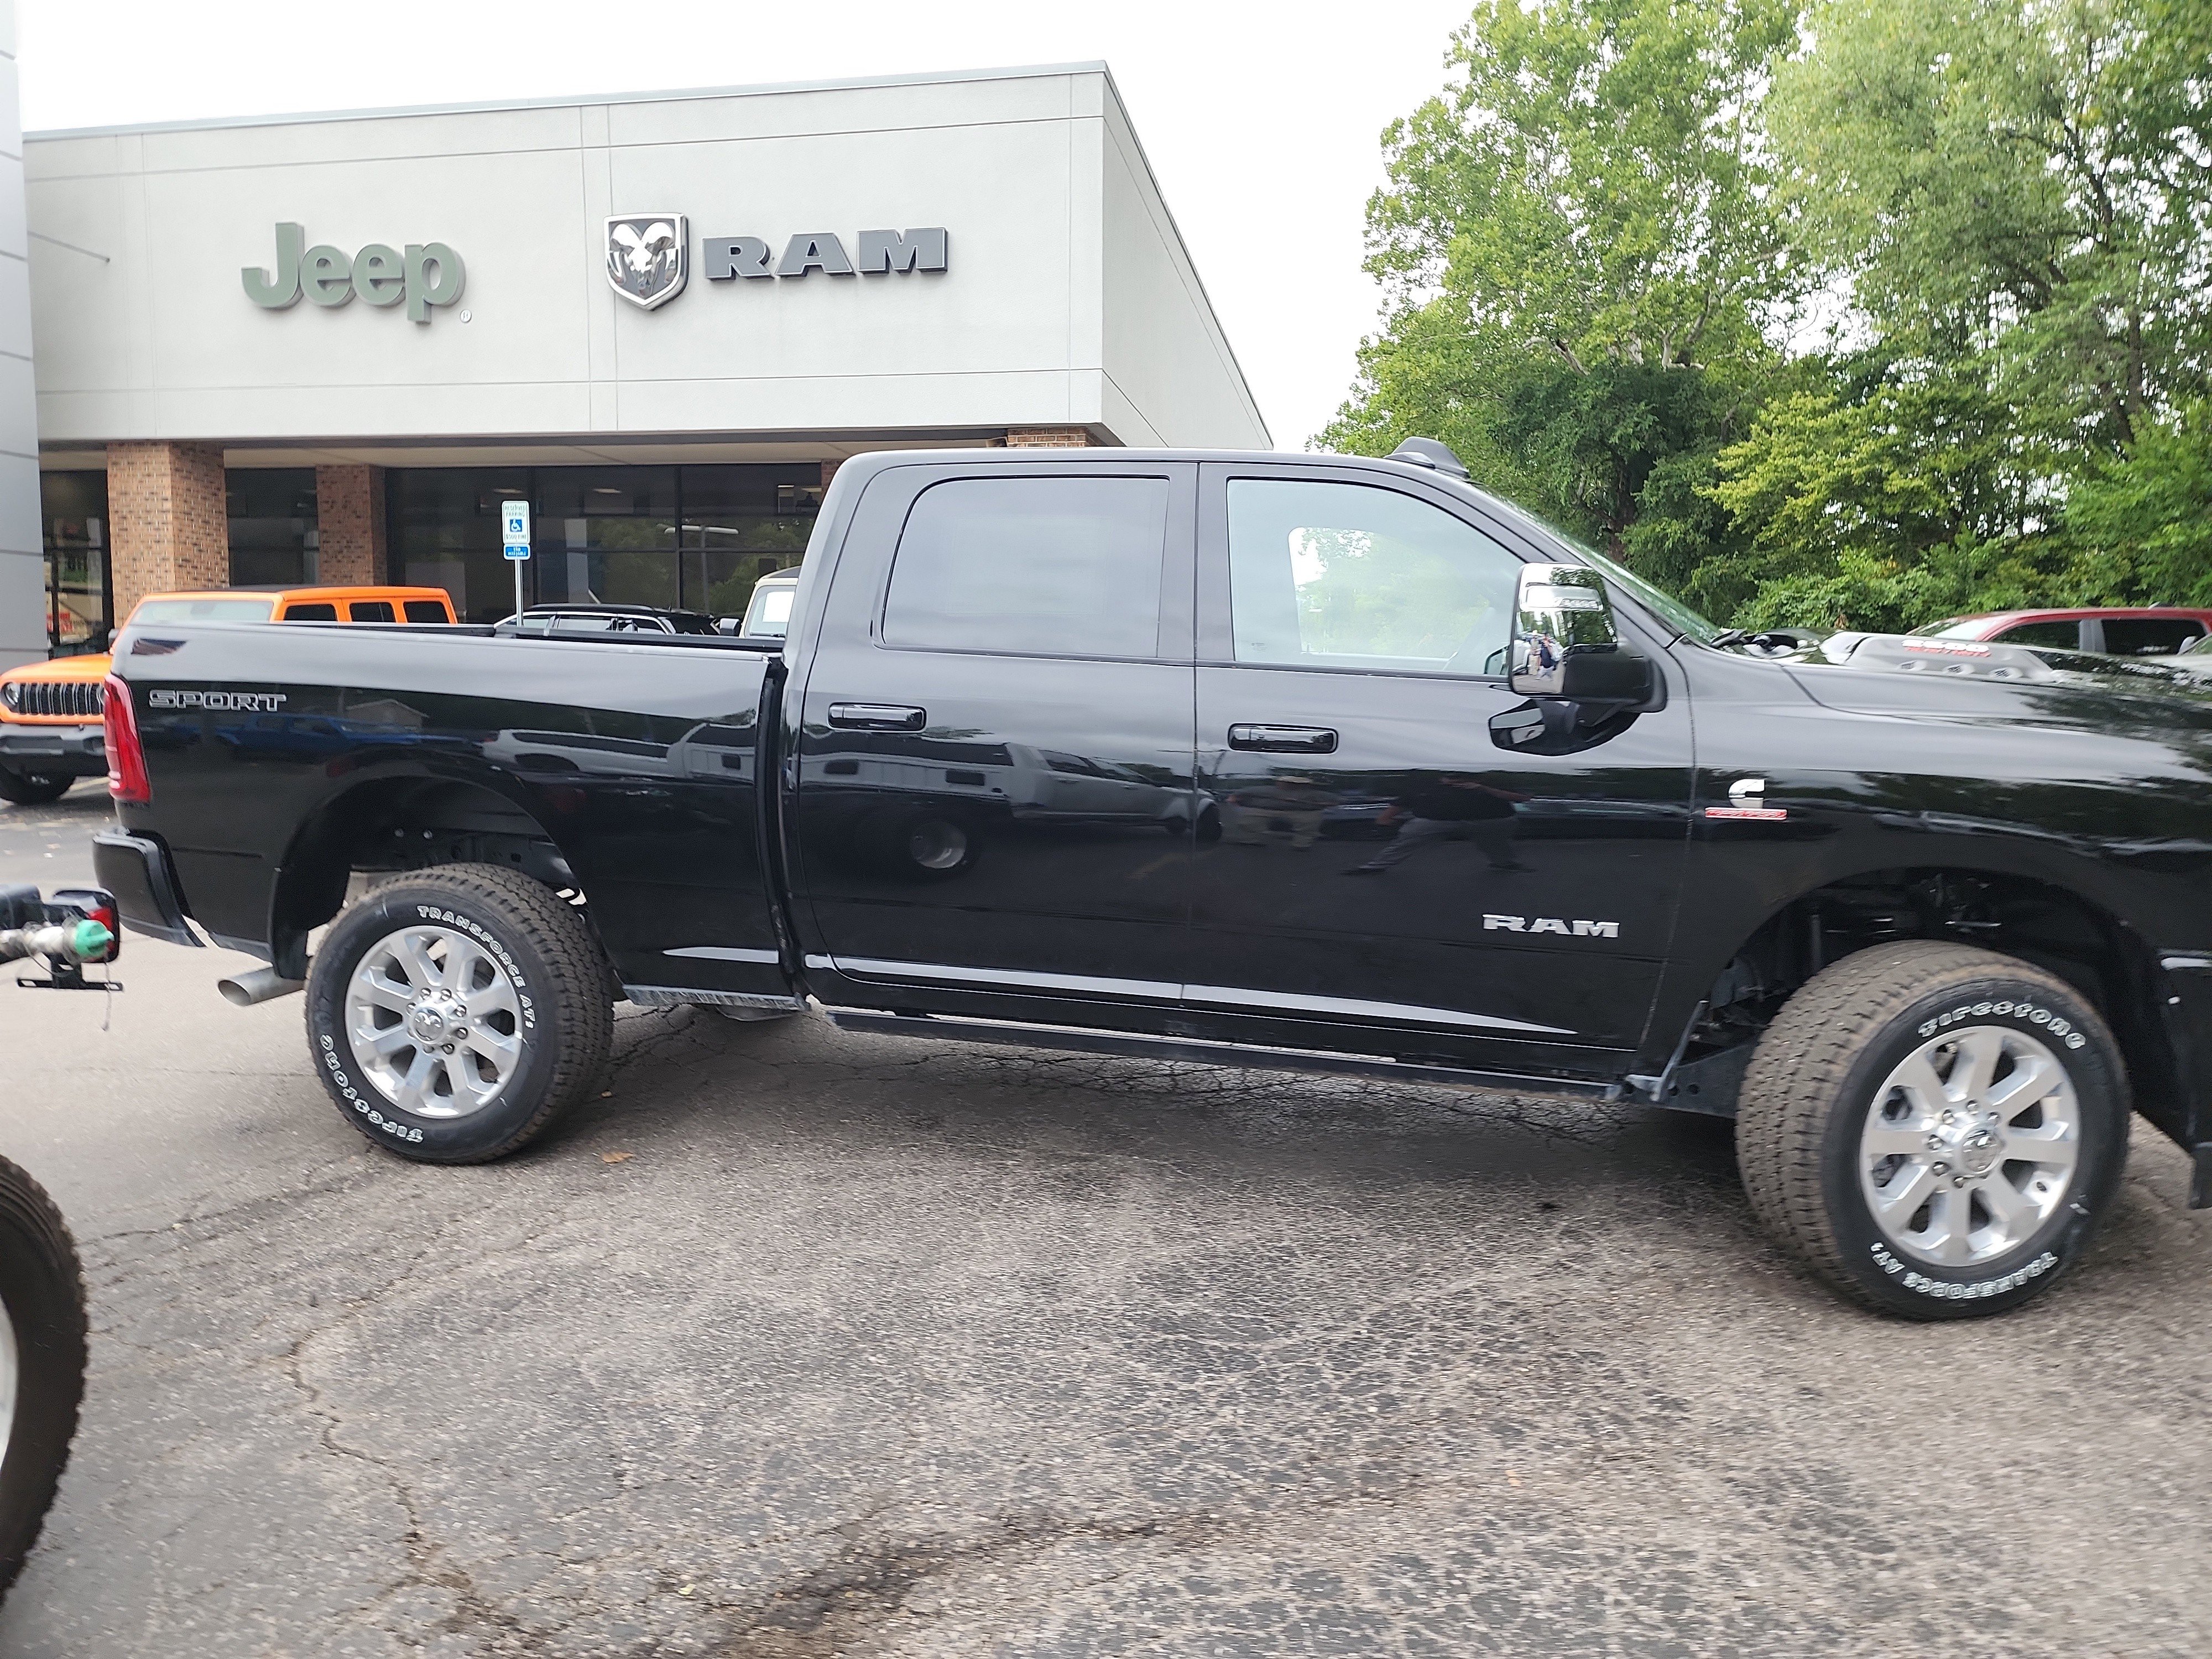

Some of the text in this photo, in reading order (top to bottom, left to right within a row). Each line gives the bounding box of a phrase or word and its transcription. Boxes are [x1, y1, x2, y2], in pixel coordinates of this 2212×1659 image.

[241, 222, 466, 324] Jeep
[701, 227, 949, 282] RAM
[149, 690, 287, 712] SPORT
[416, 905, 525, 988] TRANSFORCE
[1482, 914, 1620, 938] RAM
[1918, 1000, 2086, 1050] Firestone
[319, 1034, 424, 1144] Firestone
[1902, 1251, 2059, 1300] TRANSFORCE
